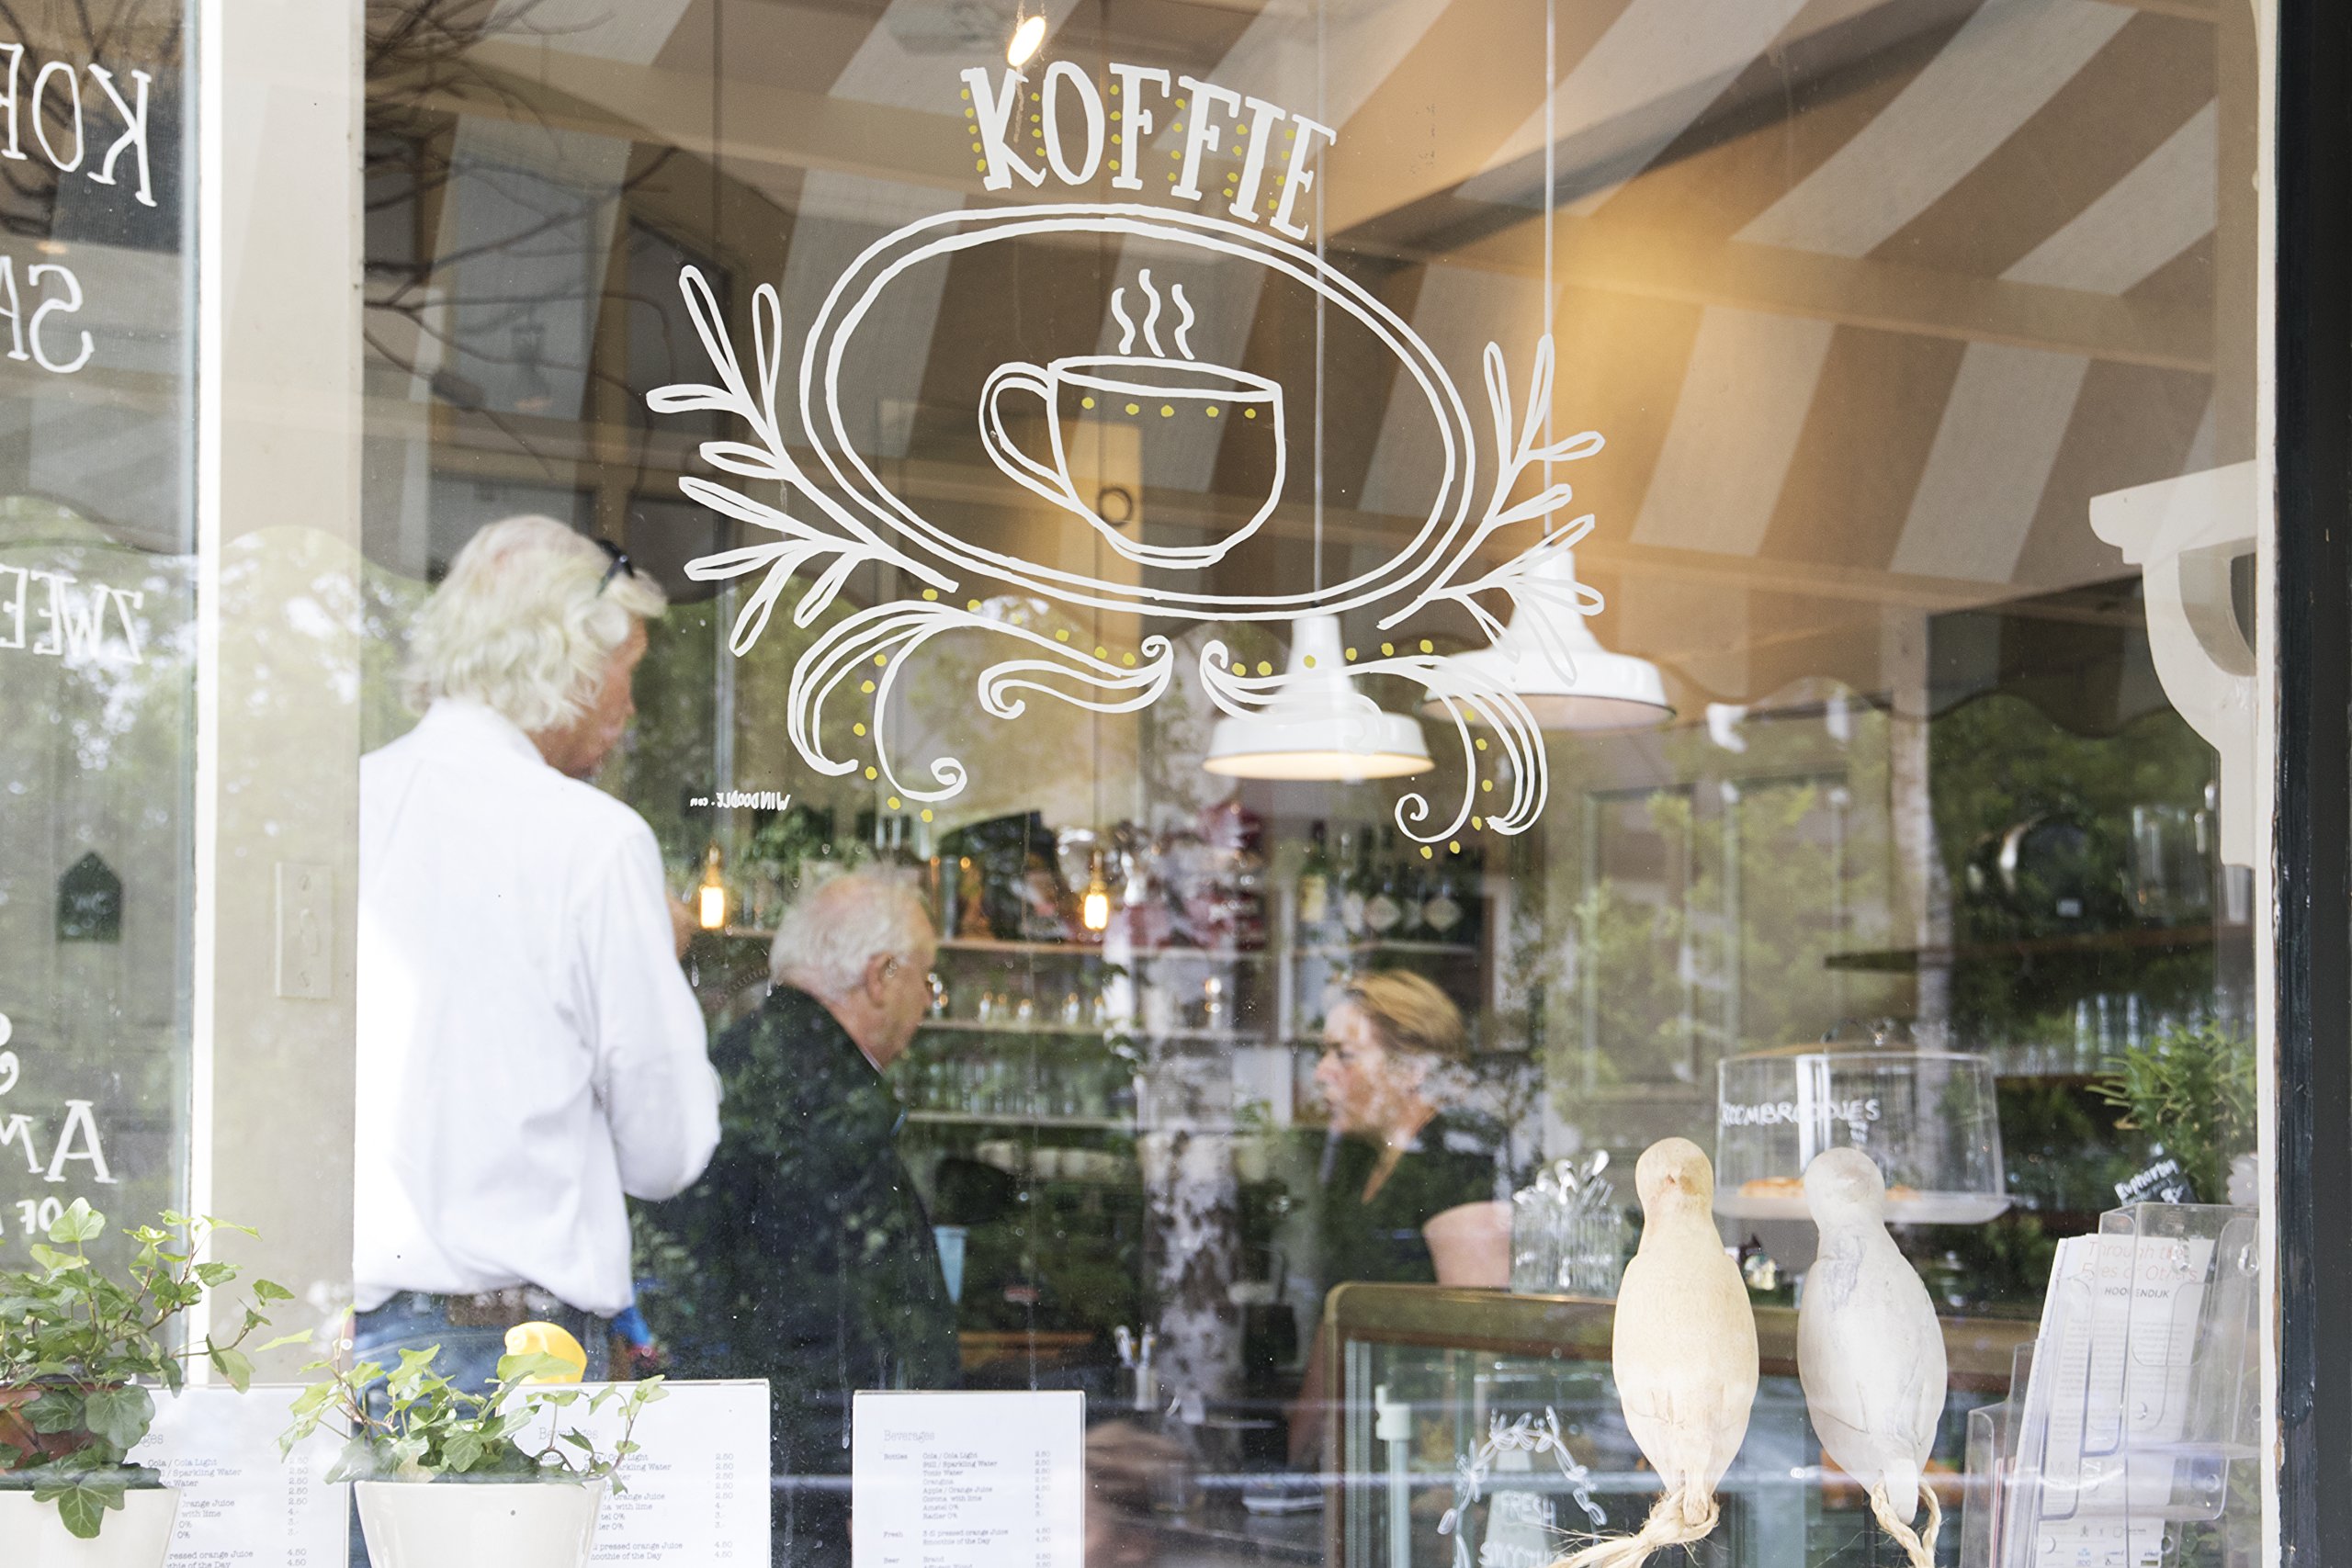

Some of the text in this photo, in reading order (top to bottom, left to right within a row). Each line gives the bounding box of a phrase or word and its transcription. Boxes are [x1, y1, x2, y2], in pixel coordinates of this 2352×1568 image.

[960, 61, 1336, 240] KOFFIE
[1722, 1099, 1881, 1126] ROOMBRDJES
[2082, 1263, 2118, 1280] Ees
[538, 1427, 598, 1439] Beeres
[883, 1429, 935, 1443] Beverages
[628, 1453, 649, 1461] Light
[960, 1451, 978, 1461] Light
[148, 1460, 166, 1468] Cola
[175, 1459, 193, 1467] Cola
[195, 1458, 218, 1468] Light
[617, 1463, 646, 1472] arkling
[943, 1461, 977, 1469] Sparkling
[173, 1469, 215, 1478] Sparkling
[217, 1468, 242, 1476] Water
[922, 1486, 943, 1495] Apple
[948, 1486, 973, 1495] Orange
[883, 1530, 904, 1539] Fresh
[937, 1529, 964, 1538] pressed
[965, 1529, 989, 1538] orange
[600, 1543, 631, 1551] pressed
[632, 1542, 660, 1551] orange
[662, 1541, 683, 1550] Juice
[922, 1538, 956, 1546] Smoothie
[978, 1537, 991, 1546] Day
[169, 1551, 197, 1560] ressed
[198, 1551, 229, 1560] orange
[230, 1550, 254, 1558] Juice
[591, 1552, 621, 1561] oothie
[647, 1551, 662, 1561] Day
